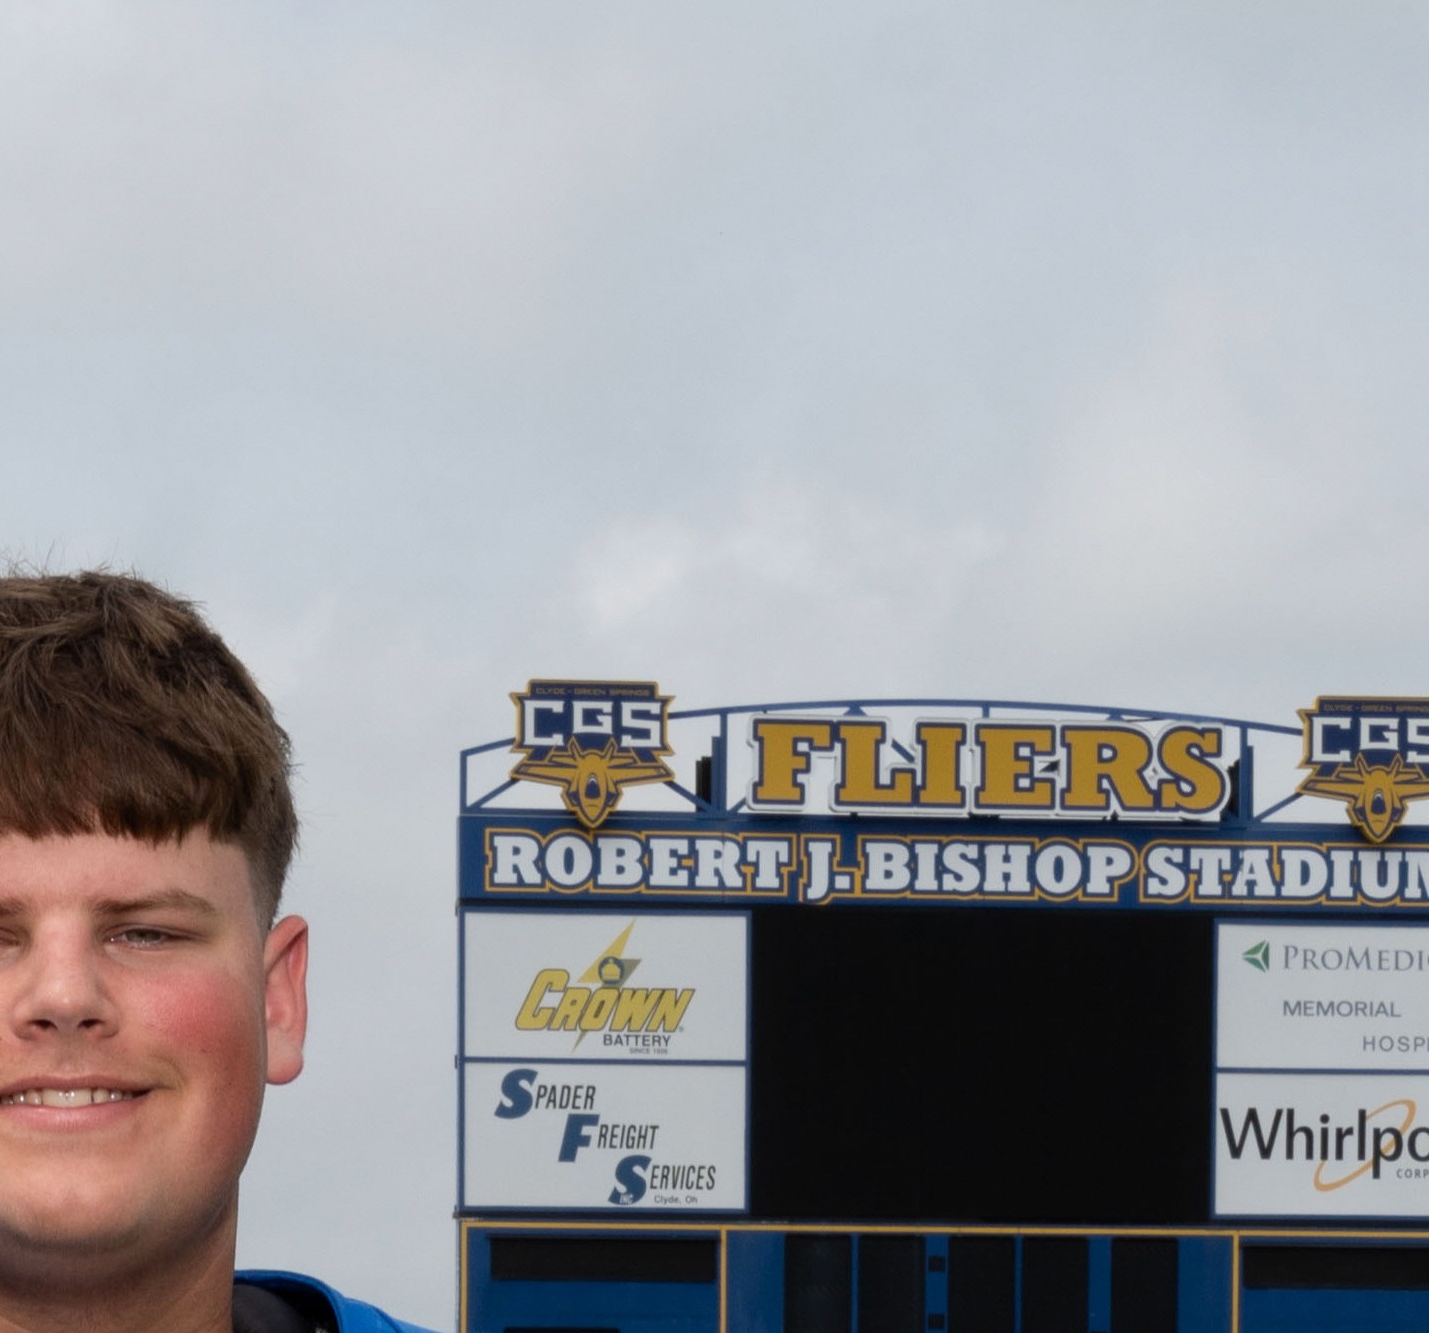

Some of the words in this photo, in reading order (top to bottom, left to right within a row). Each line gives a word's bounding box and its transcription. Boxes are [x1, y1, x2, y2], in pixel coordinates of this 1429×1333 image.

[523, 700, 662, 747] CGS
[751, 716, 1229, 815] FLIERS
[492, 834, 790, 891] ROBERT
[806, 840, 852, 899] J.
[864, 840, 1132, 895] BISHOP
[515, 968, 696, 1033] CROWN
[1283, 1000, 1402, 1018] MEMORIAL
[603, 1033, 672, 1047] BATTERY
[494, 1068, 597, 1119] SPADER
[558, 1113, 660, 1163] FREIGHT
[608, 1154, 717, 1205] SERVICES
